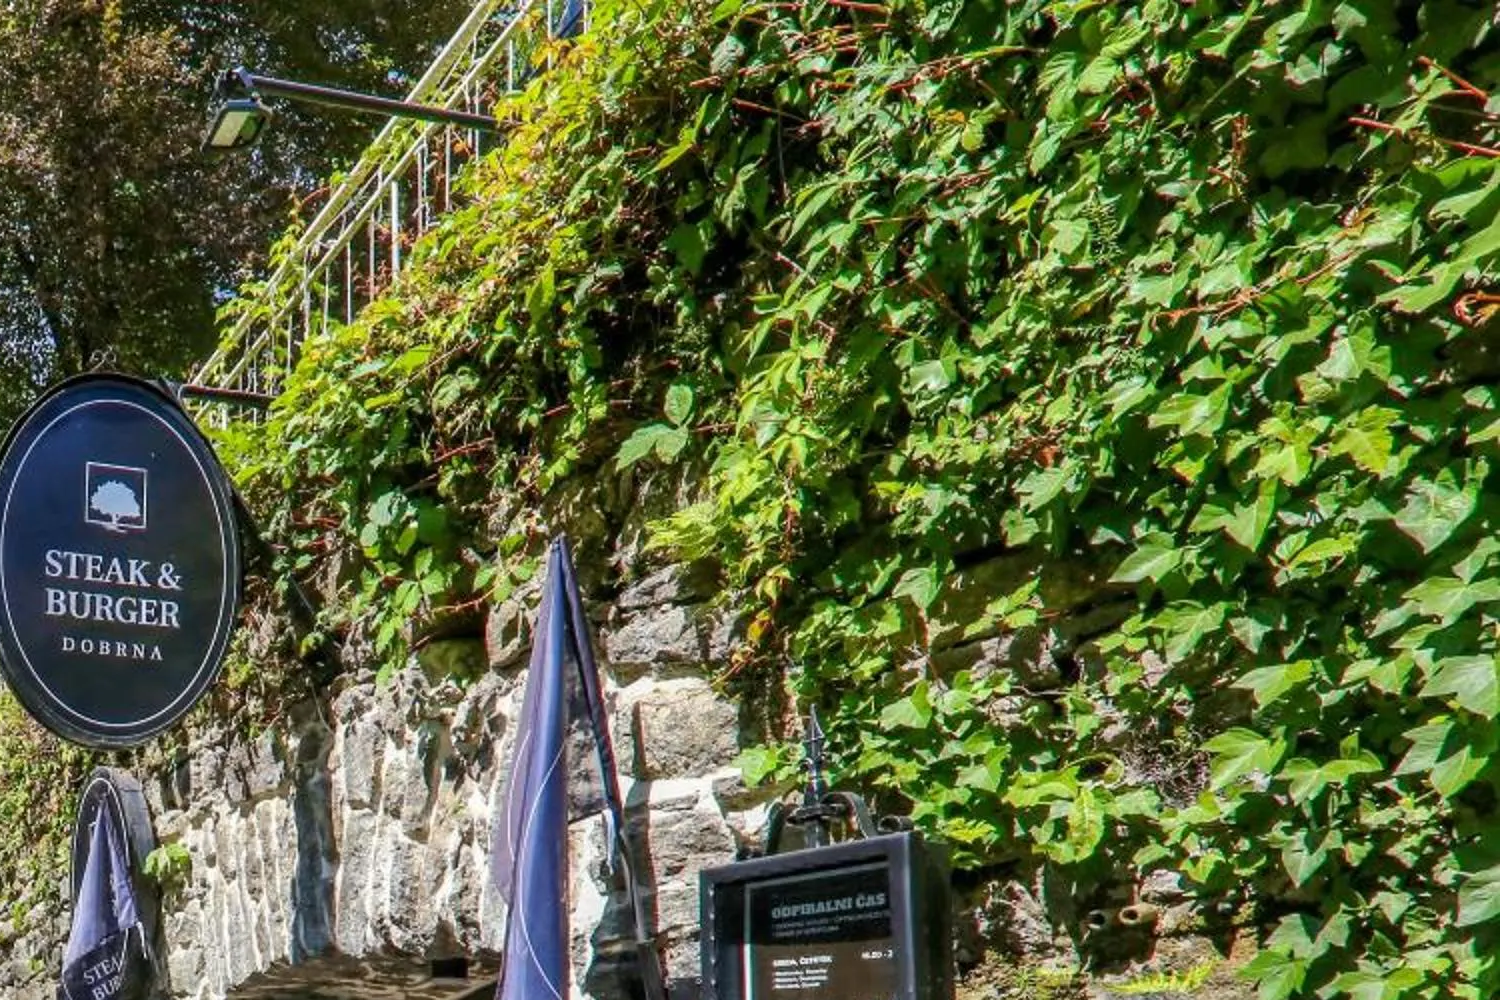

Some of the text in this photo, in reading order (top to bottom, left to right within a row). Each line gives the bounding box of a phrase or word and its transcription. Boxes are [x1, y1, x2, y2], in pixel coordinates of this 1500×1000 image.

[45, 549, 183, 591] STEAK &
[44, 587, 180, 629] BURGER
[62, 637, 163, 661] DOBRNA
